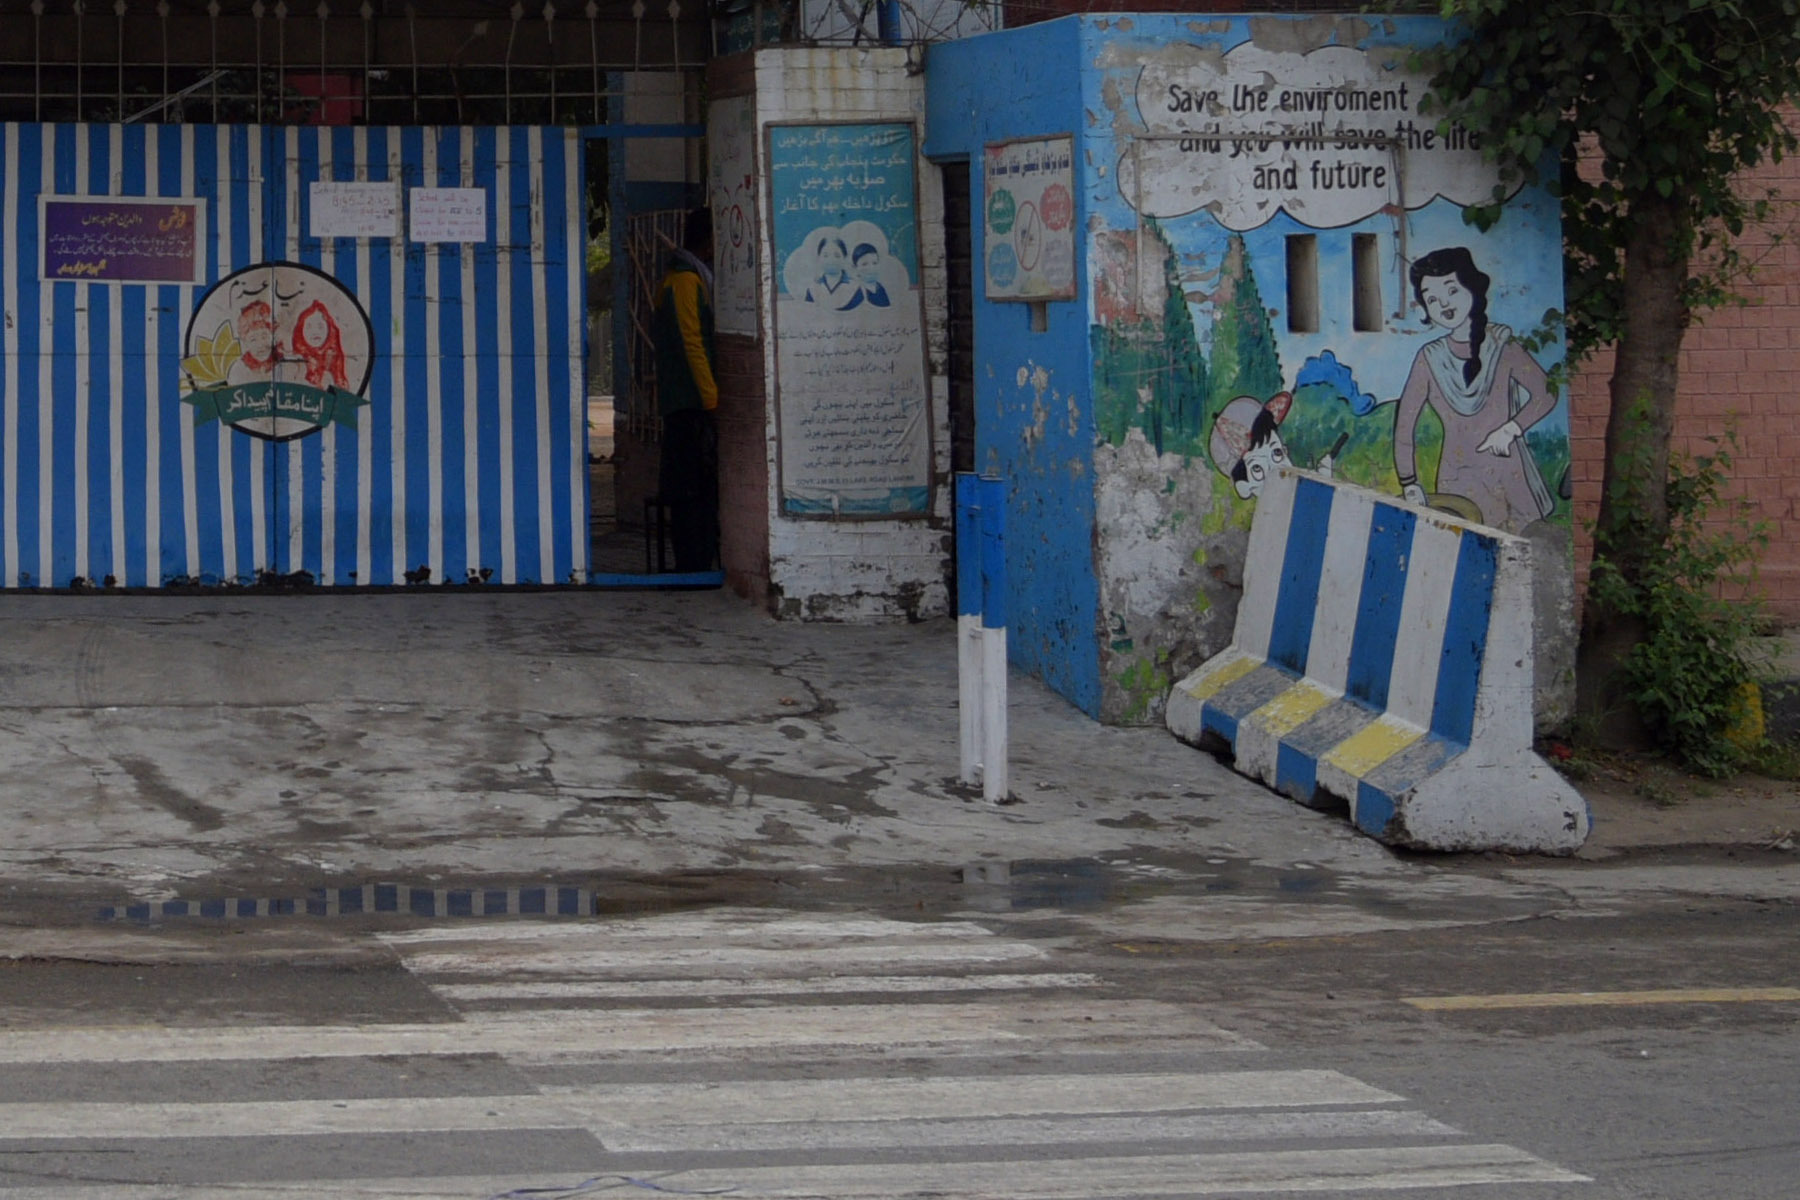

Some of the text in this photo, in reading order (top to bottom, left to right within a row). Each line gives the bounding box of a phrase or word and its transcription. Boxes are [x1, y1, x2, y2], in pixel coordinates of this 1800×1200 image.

[1167, 84, 1218, 113] Save
[1279, 80, 1409, 114] enviroment
[1179, 123, 1222, 154] and
[1279, 120, 1325, 152] will
[1332, 126, 1387, 152] save
[1393, 119, 1436, 152] the
[1253, 158, 1387, 191] and future
